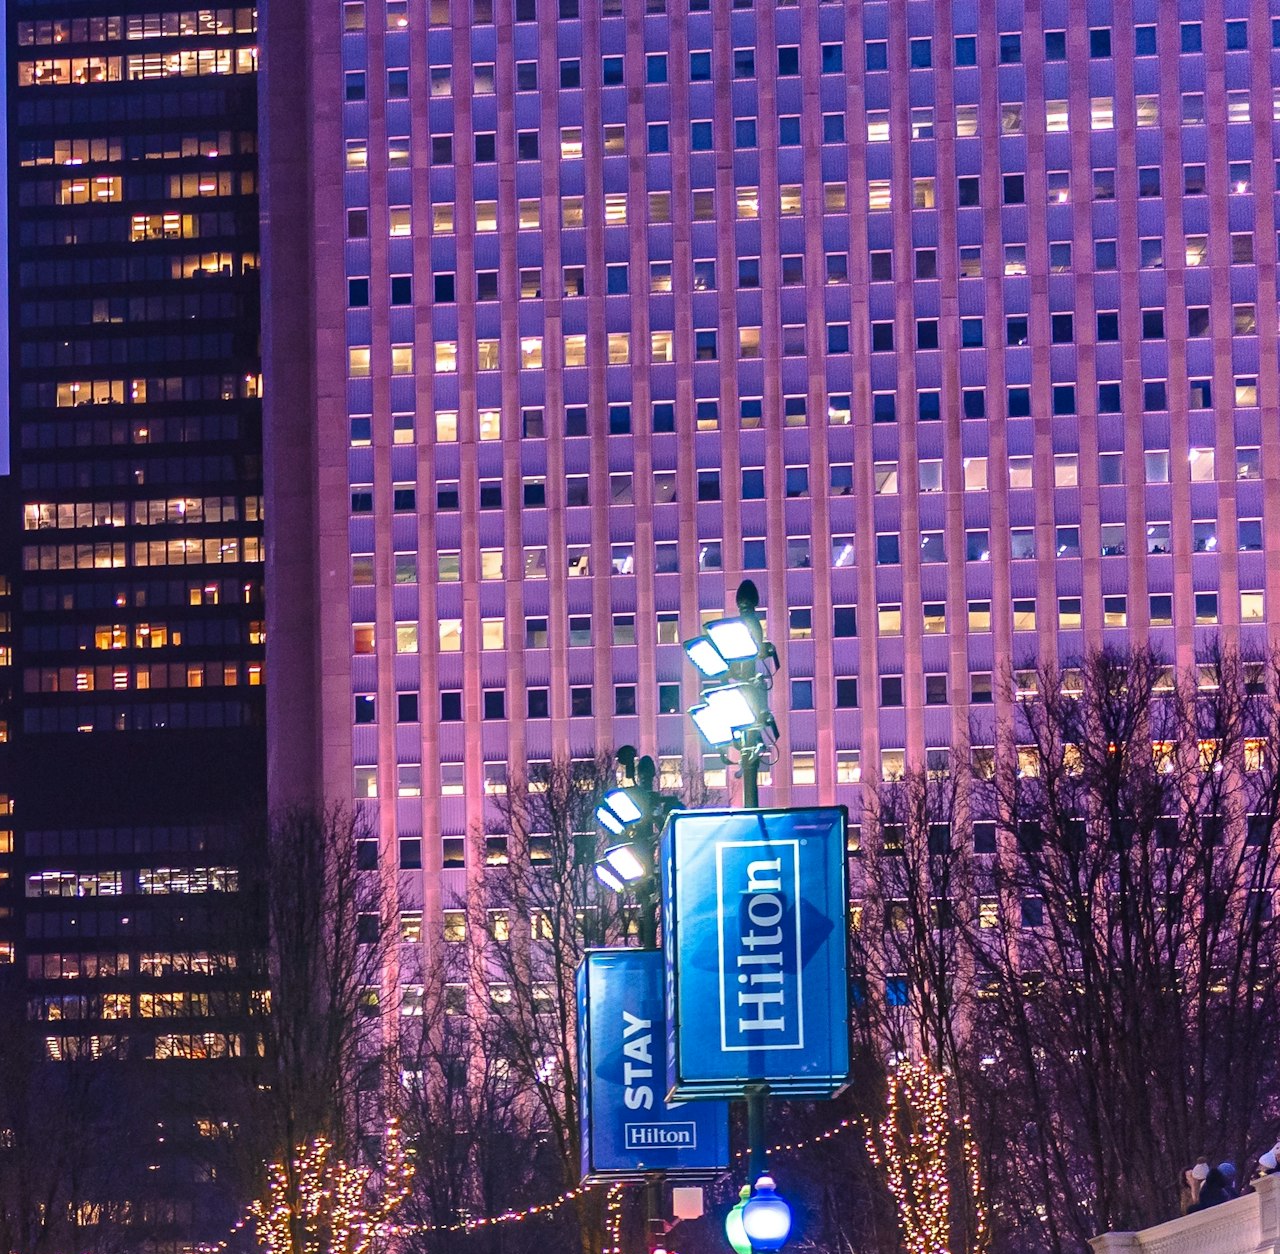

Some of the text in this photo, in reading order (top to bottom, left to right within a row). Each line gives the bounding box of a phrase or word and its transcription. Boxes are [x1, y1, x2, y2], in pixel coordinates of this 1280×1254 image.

[737, 857, 785, 1033] Hilton
[623, 1010, 653, 1110] STAY
[631, 1128, 690, 1144] Hilton
